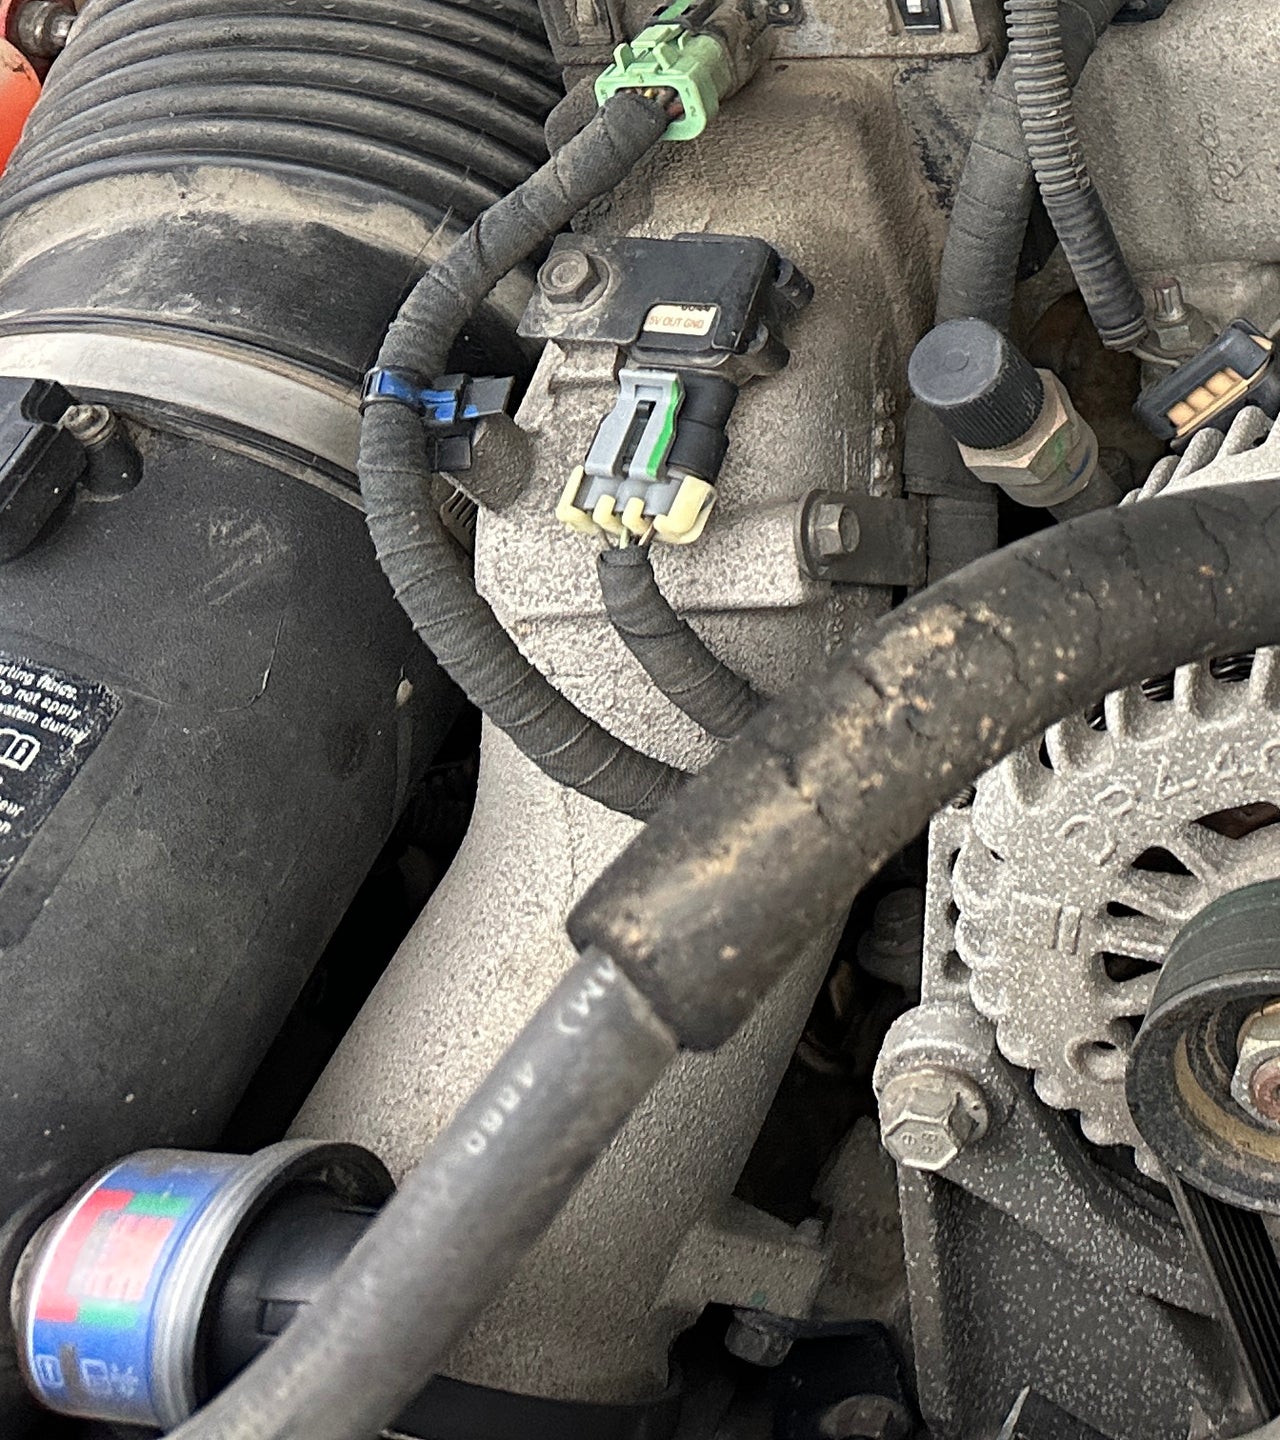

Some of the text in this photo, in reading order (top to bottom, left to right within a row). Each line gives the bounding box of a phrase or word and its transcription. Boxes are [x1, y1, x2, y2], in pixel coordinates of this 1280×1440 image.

[662, 316, 683, 328] OUT
[683, 318, 705, 330] GND
[14, 688, 42, 706] not
[40, 697, 82, 721] apply
